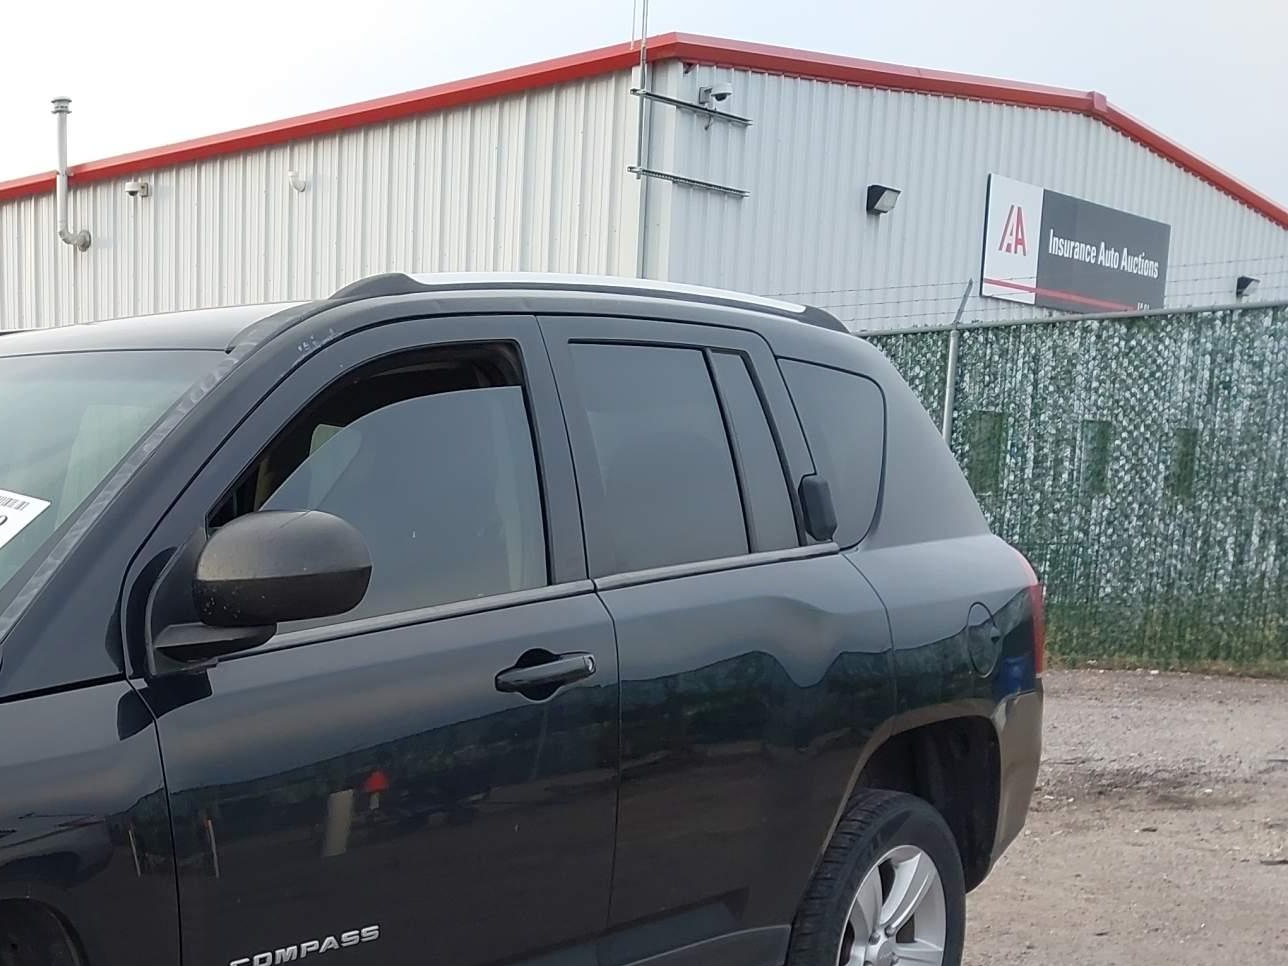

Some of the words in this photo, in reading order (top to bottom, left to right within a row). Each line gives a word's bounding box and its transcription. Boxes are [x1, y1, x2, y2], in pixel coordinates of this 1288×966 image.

[1048, 228, 1097, 264] Insurance
[1097, 241, 1119, 270] Auto
[1120, 247, 1160, 280] Auctions
